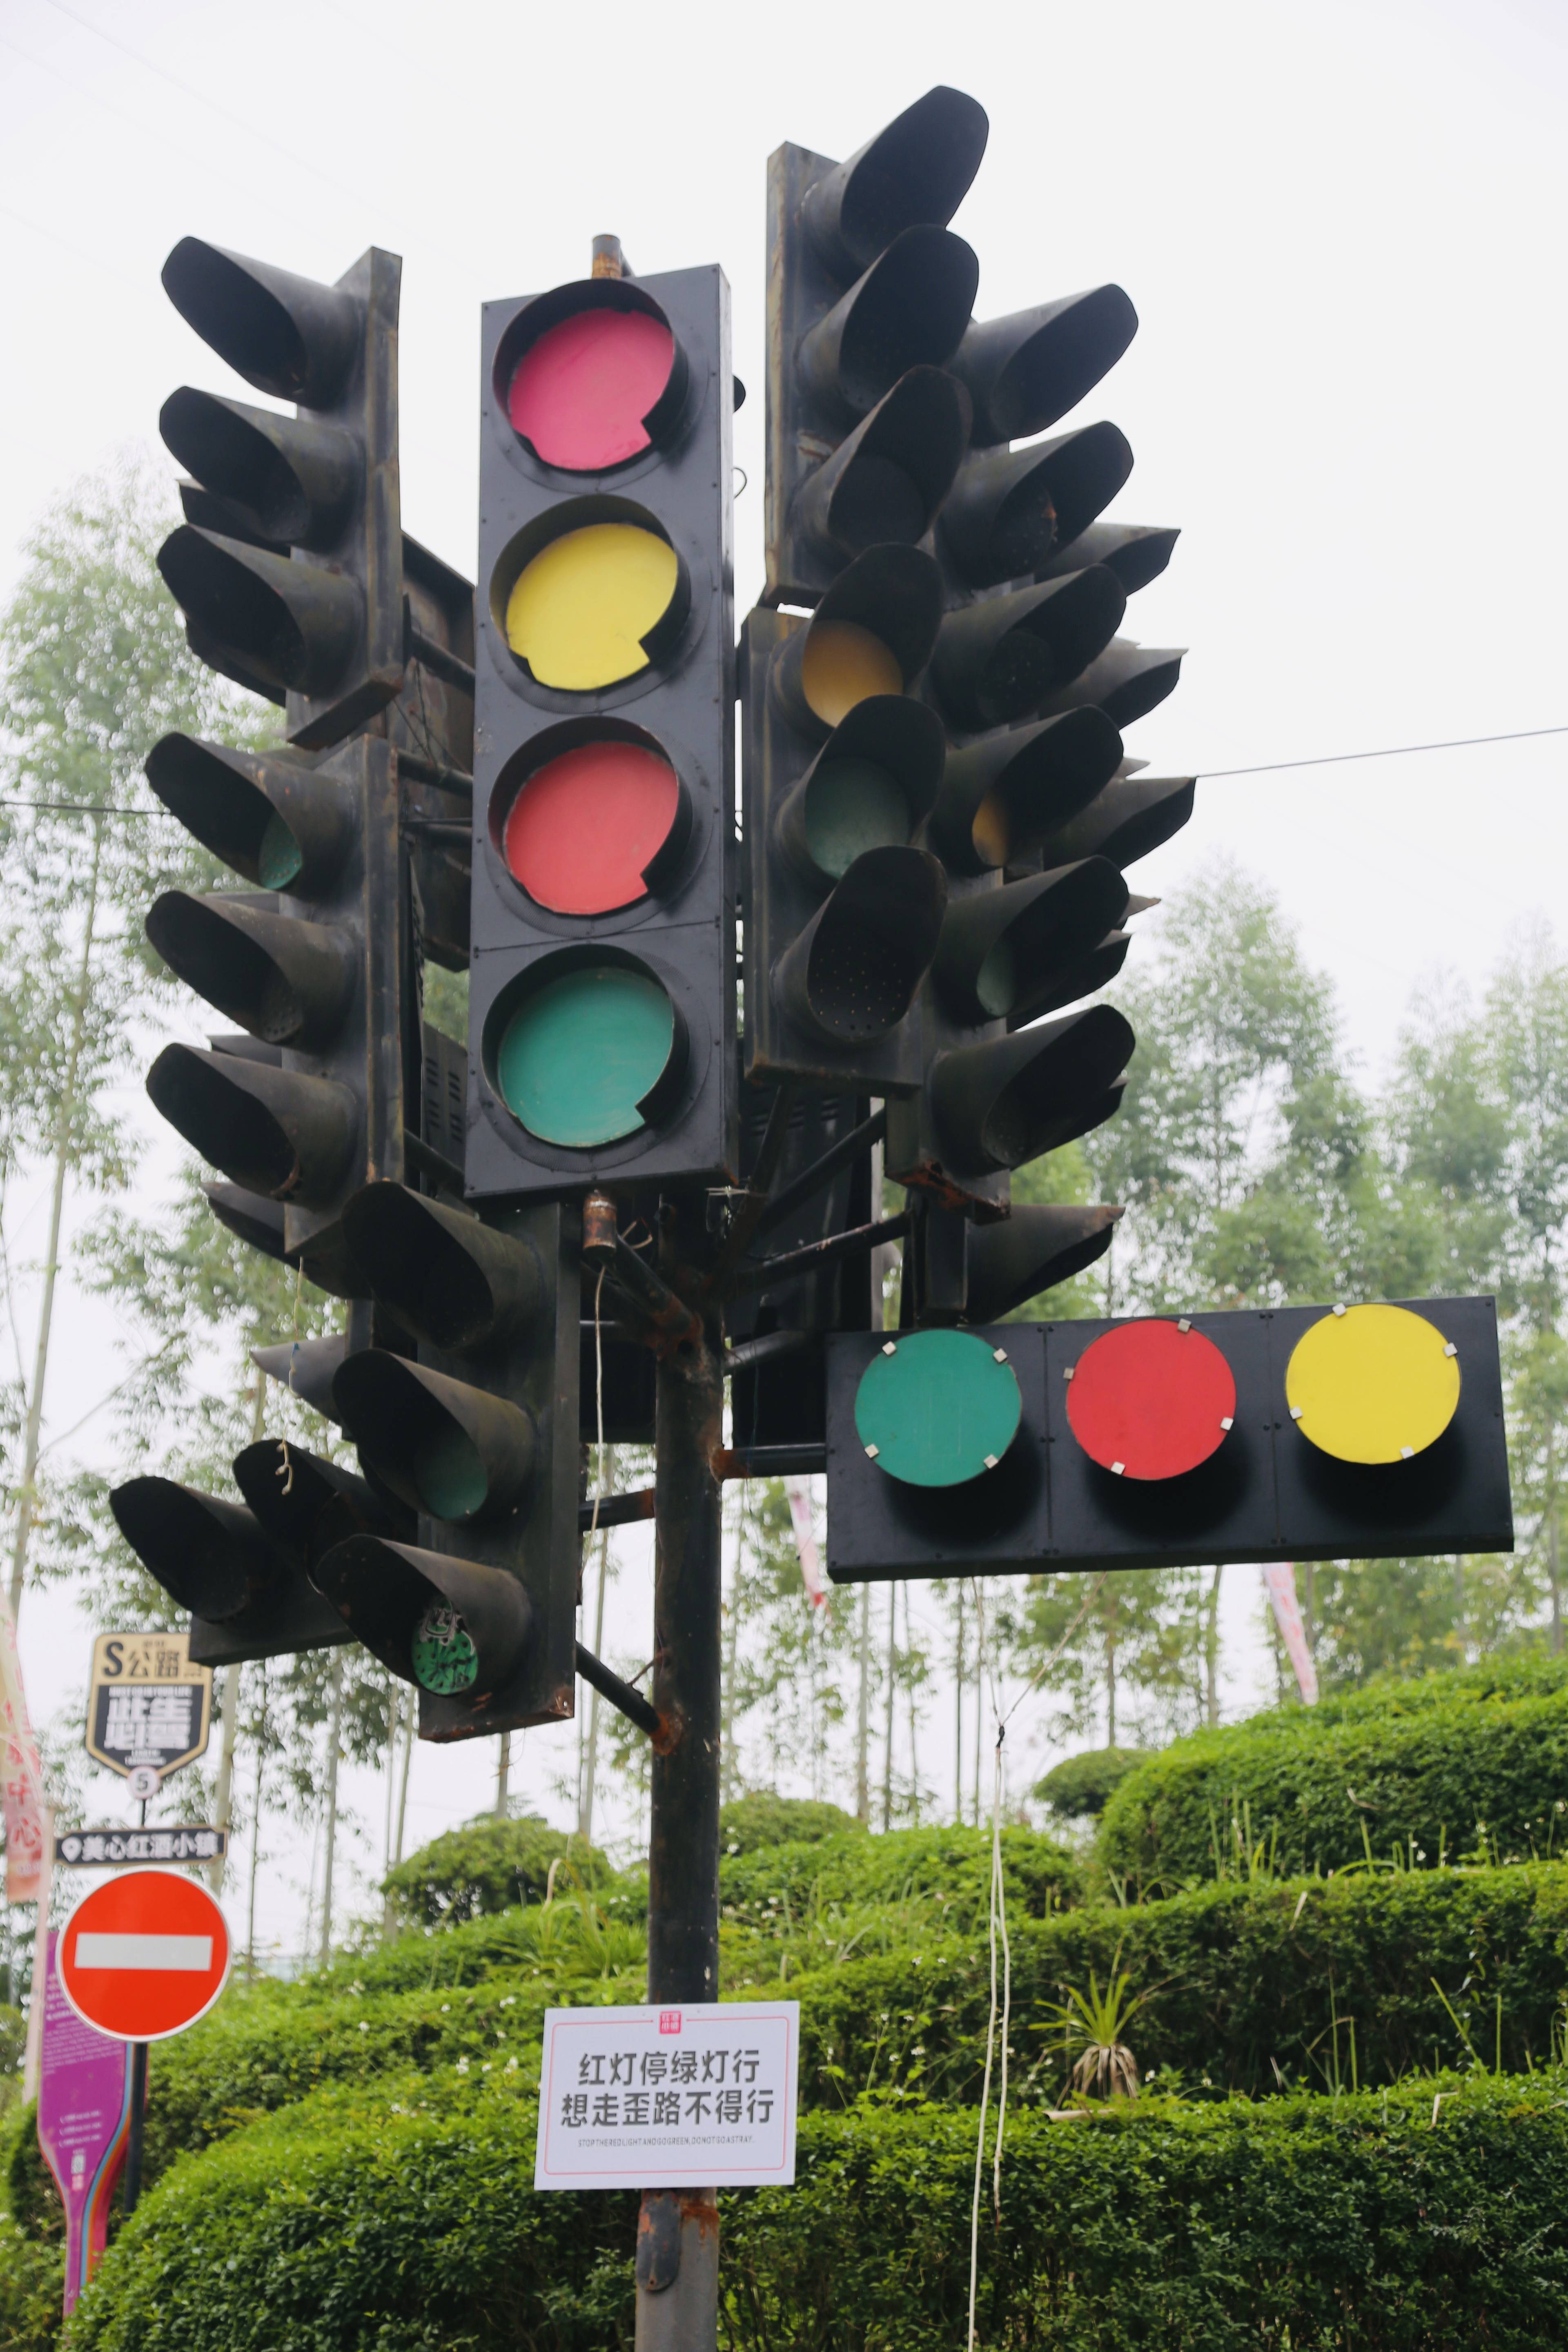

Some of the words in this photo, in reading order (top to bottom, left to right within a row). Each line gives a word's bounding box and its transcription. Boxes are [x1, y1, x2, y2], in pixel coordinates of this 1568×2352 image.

[137, 1773, 148, 1792] 5
[578, 2049, 760, 2086] 红灯停绿灯行
[561, 2089, 774, 2128] 想走歪路不得行
